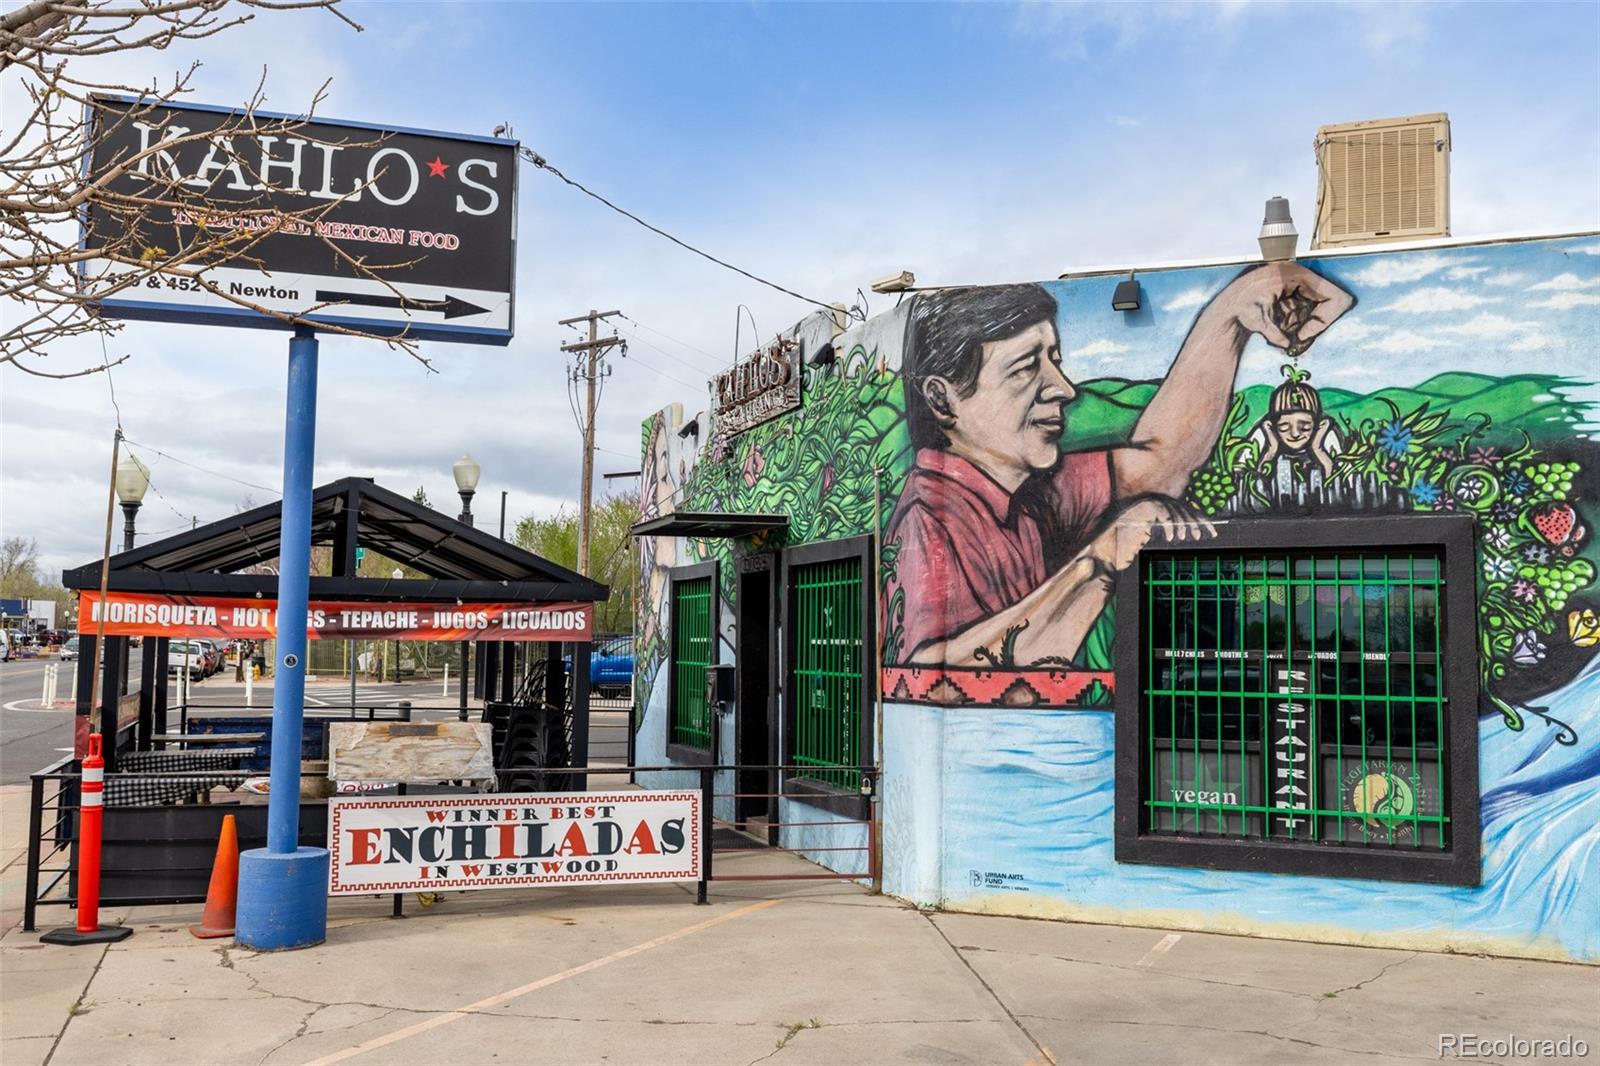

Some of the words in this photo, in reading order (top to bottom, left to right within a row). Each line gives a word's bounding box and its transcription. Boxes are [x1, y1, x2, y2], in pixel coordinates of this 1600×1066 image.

[172, 208, 311, 236] TRDITIOAL
[315, 222, 403, 245] MEXICAN
[408, 230, 459, 251] FOOD
[146, 275, 161, 289] &
[166, 277, 201, 292] 452
[230, 282, 299, 300] Newton
[91, 601, 217, 627] MORISQUETA
[232, 607, 271, 627] HOT
[340, 610, 418, 629] TEPACHE
[432, 611, 489, 629] JUGOS
[502, 611, 586, 630] LICUADOS
[1214, 651, 1249, 659] SMOOTHIS
[1275, 670, 1308, 829] RESTAURANT
[1341, 761, 1408, 792] VEGETARAN
[1171, 789, 1238, 806] vegan
[426, 807, 539, 824] WINNER
[550, 805, 615, 821] BEST
[345, 816, 686, 866] ENCHILADAS
[419, 864, 449, 880] IN
[460, 859, 618, 879] WESTWOOD
[984, 872, 1007, 880] URBAN
[1007, 873, 1025, 881] ARTS
